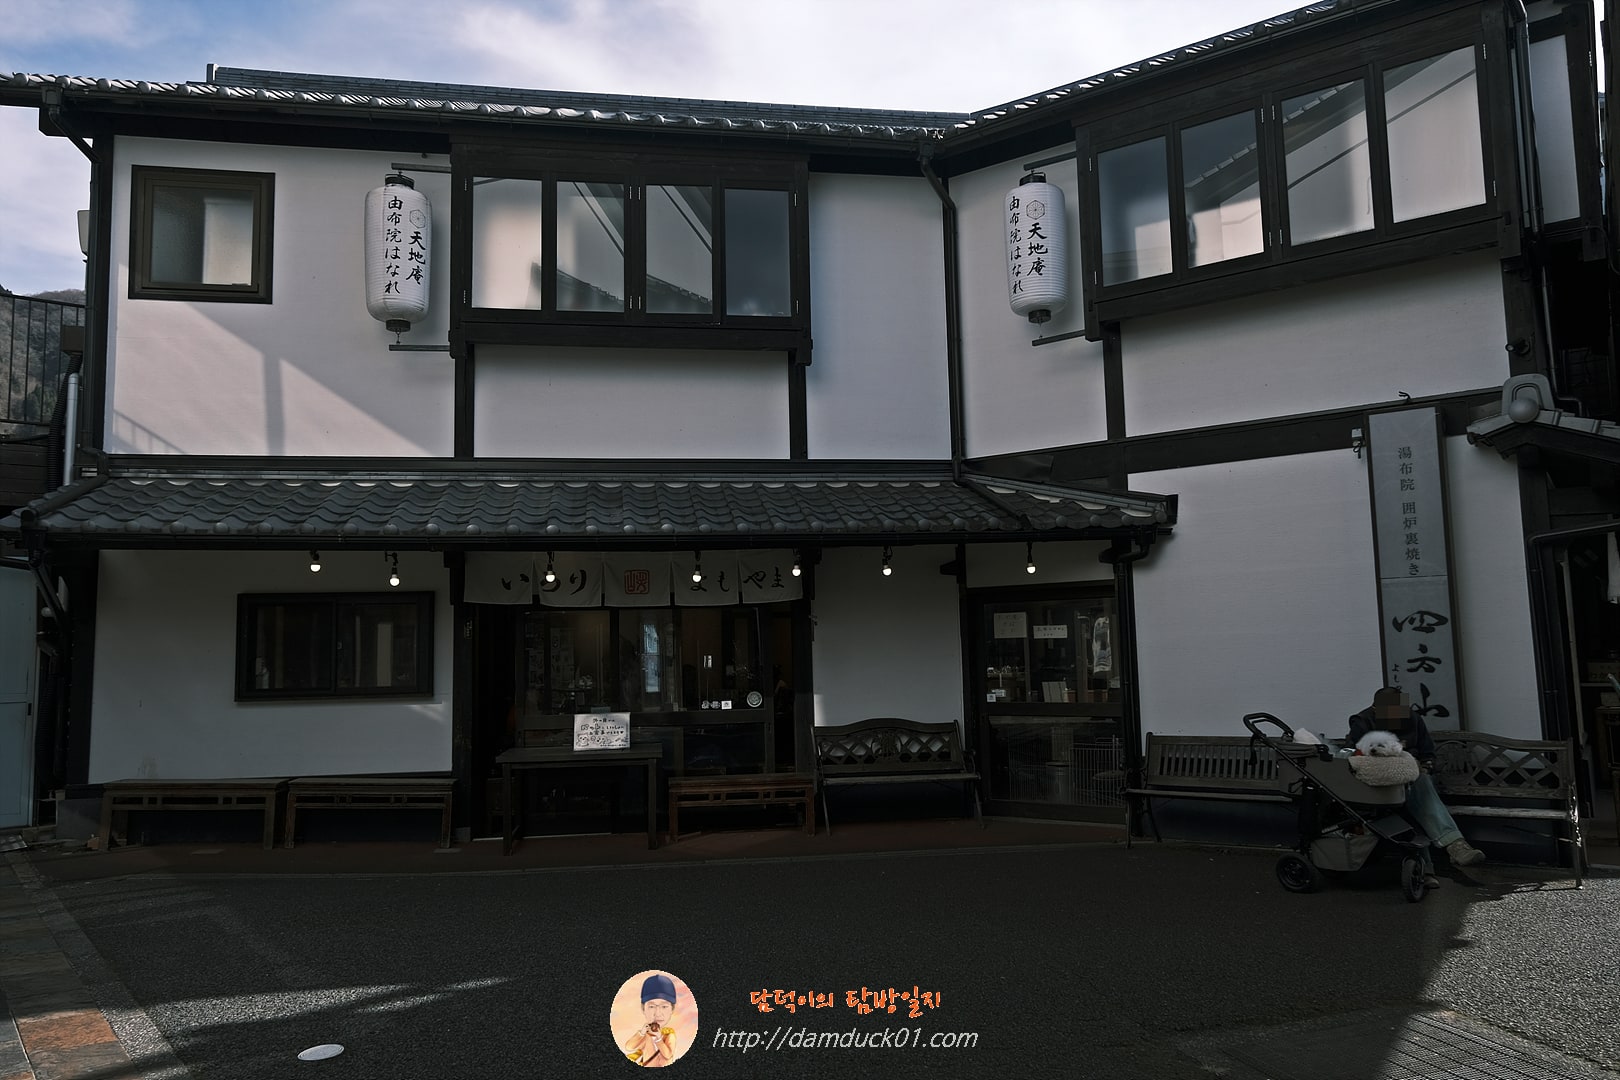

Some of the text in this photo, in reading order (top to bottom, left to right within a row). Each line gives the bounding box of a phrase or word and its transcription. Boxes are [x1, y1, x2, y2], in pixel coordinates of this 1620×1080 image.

[384, 196, 403, 293] 由布院はなれ
[406, 231, 426, 284] 天地庵
[1009, 196, 1024, 294] 由布院はなれ
[1027, 222, 1048, 276] 天地庵
[1398, 446, 1421, 576] 湯布院 囲炉裏焼き
